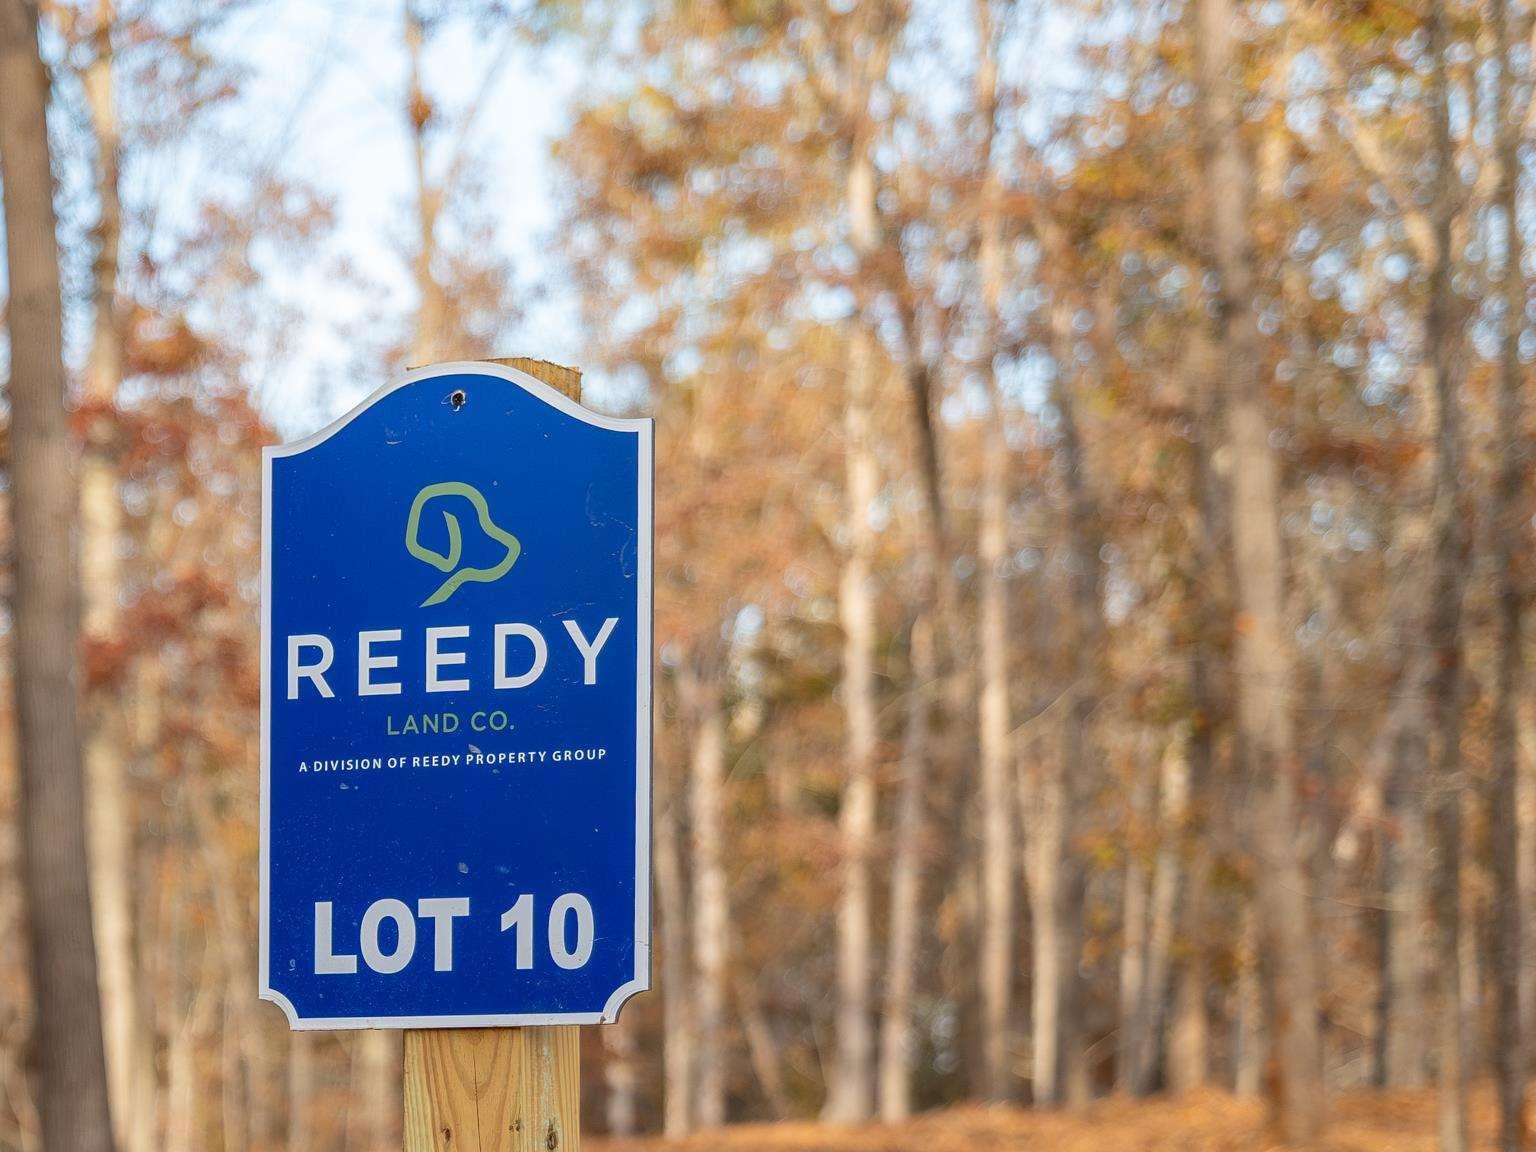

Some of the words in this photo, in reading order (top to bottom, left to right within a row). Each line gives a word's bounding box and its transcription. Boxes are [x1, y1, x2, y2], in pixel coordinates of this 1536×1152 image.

[287, 617, 620, 700] REEDY
[386, 713, 460, 736] LAND
[470, 710, 515, 733] CO.
[299, 761, 308, 773] A
[313, 758, 382, 773] DIVISION
[387, 756, 407, 769] OF
[412, 755, 460, 768] REEDY
[466, 751, 547, 766] PROPERTY
[552, 748, 607, 763] GROUP
[314, 897, 470, 976] LOT
[500, 892, 596, 971] 10
